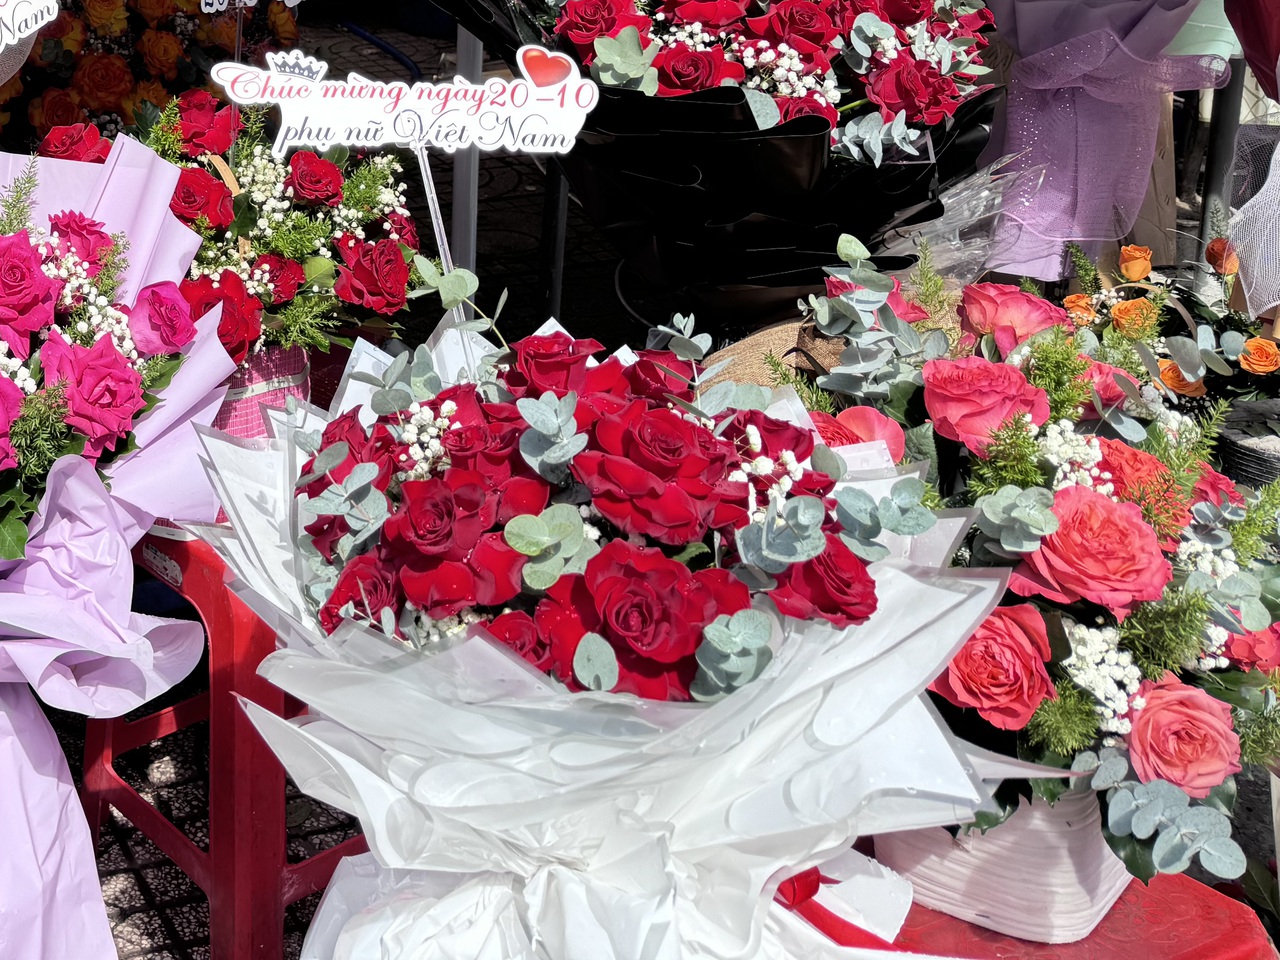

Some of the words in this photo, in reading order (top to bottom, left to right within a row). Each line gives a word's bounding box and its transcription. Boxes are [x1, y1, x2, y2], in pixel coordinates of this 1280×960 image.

[216, 65, 313, 100] Chúc
[321, 76, 407, 114] mừng
[277, 115, 336, 154] phụ
[344, 119, 384, 142] nữ
[393, 108, 471, 148] Việt
[477, 111, 571, 148] Nam
